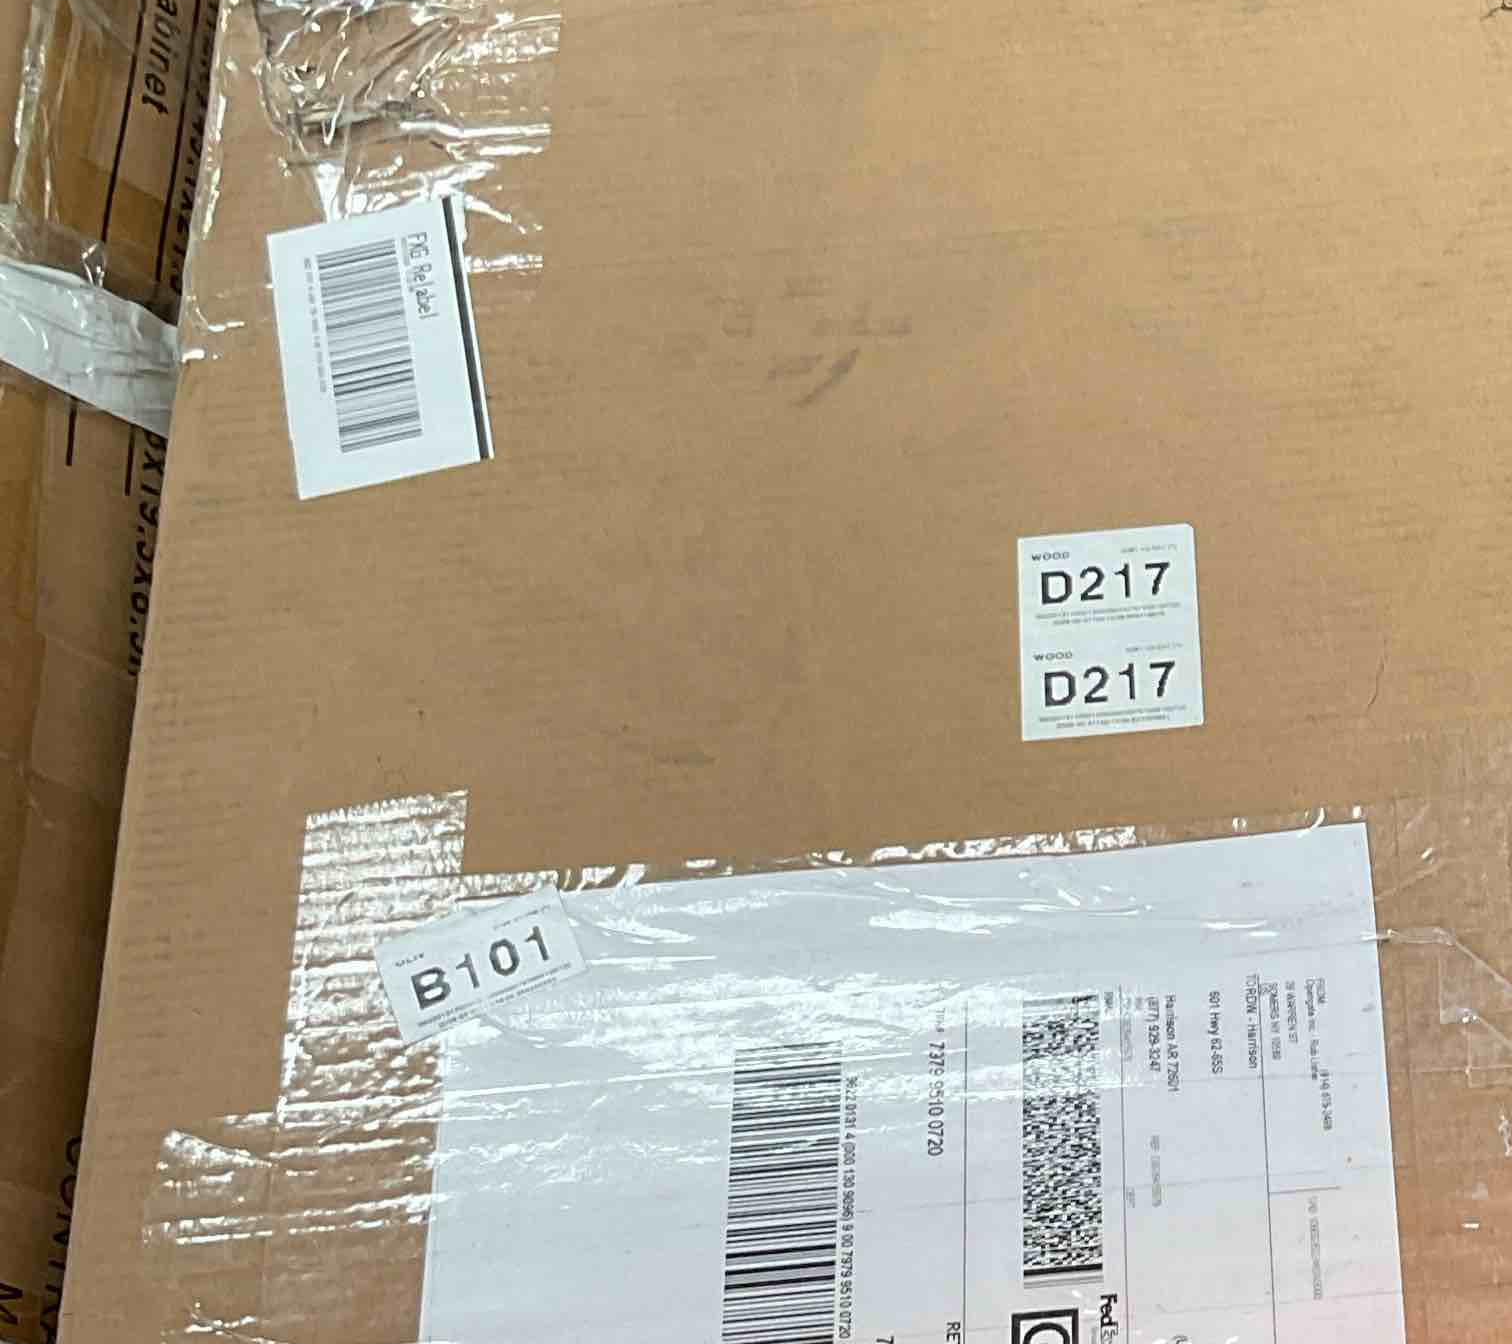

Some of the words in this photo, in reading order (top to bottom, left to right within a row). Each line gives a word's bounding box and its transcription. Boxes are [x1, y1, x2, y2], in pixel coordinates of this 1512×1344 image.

[1041, 562, 1170, 604] D217
[1044, 660, 1175, 707] D217
[410, 925, 550, 1010] B101
[1208, 1012, 1222, 1035] Hwy
[1168, 1043, 1179, 1059] AR
[845, 1132, 857, 1140] 4
[928, 1120, 944, 1156] 0720
[840, 1280, 853, 1307] 9510
[839, 1310, 852, 1339] 0720
